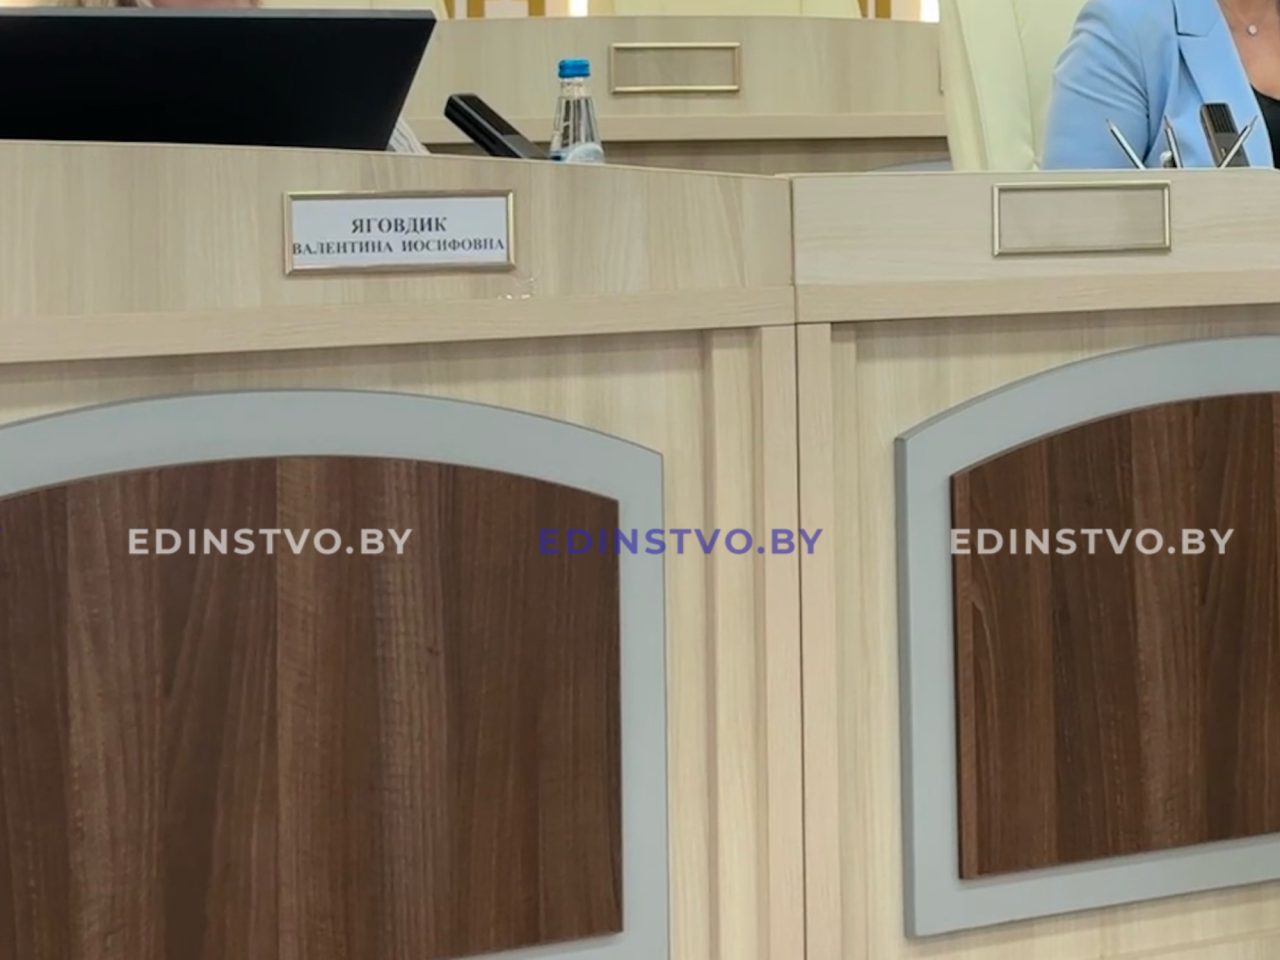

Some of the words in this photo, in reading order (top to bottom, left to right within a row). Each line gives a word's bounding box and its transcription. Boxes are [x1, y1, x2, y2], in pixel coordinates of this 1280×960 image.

[351, 216, 448, 236] ЯГОВДИК
[292, 239, 394, 256] ВАЛЕНТИНА
[401, 237, 505, 253] ИОСИФОВНА
